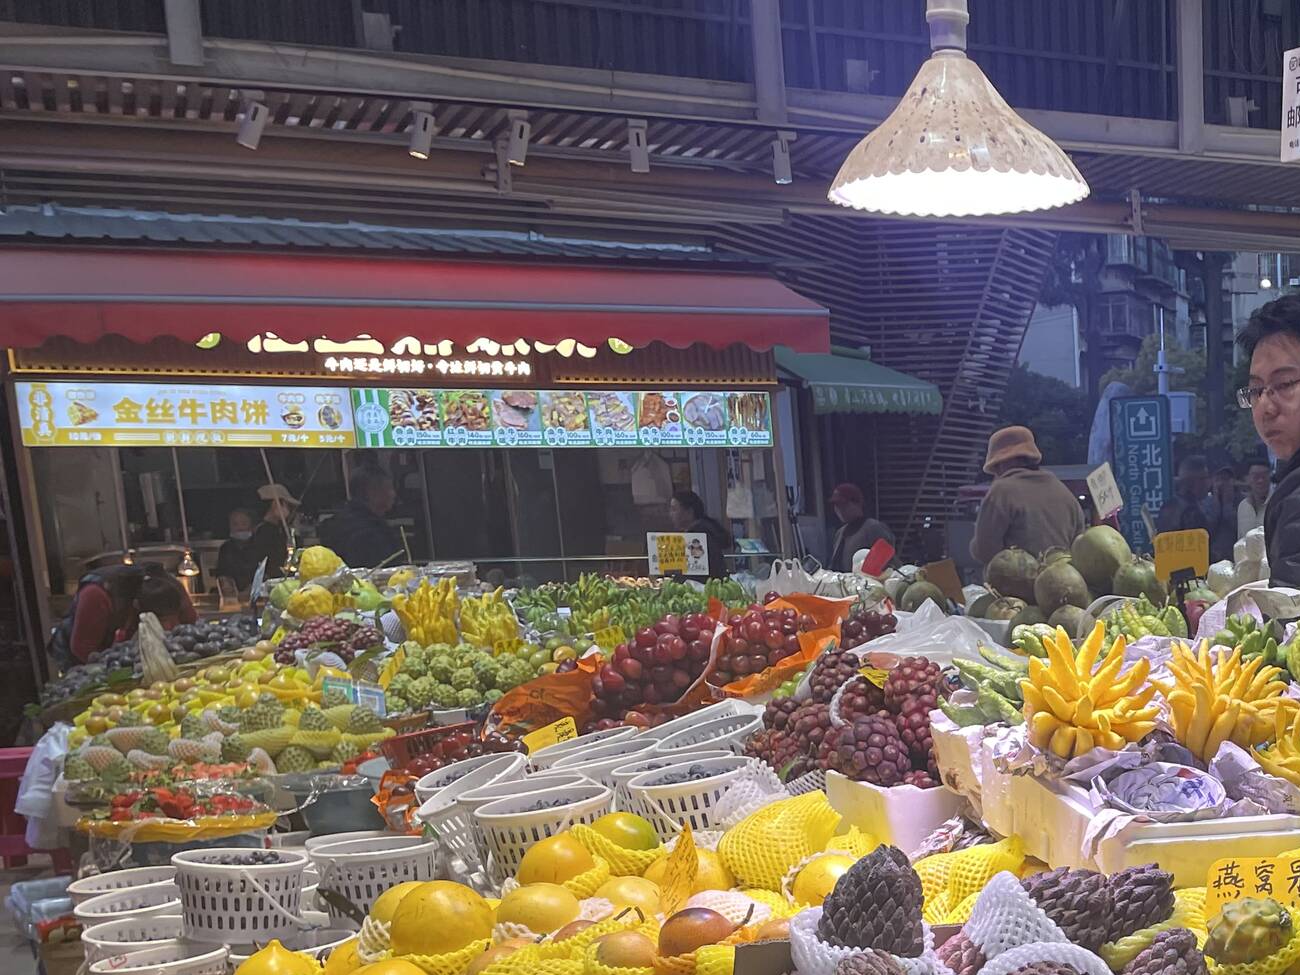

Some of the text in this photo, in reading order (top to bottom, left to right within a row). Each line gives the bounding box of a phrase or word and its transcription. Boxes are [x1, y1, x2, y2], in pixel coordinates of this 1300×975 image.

[112, 396, 270, 426] 金丝牛肉饼
[1127, 444, 1140, 480] North
[1142, 443, 1164, 518] 北门出
